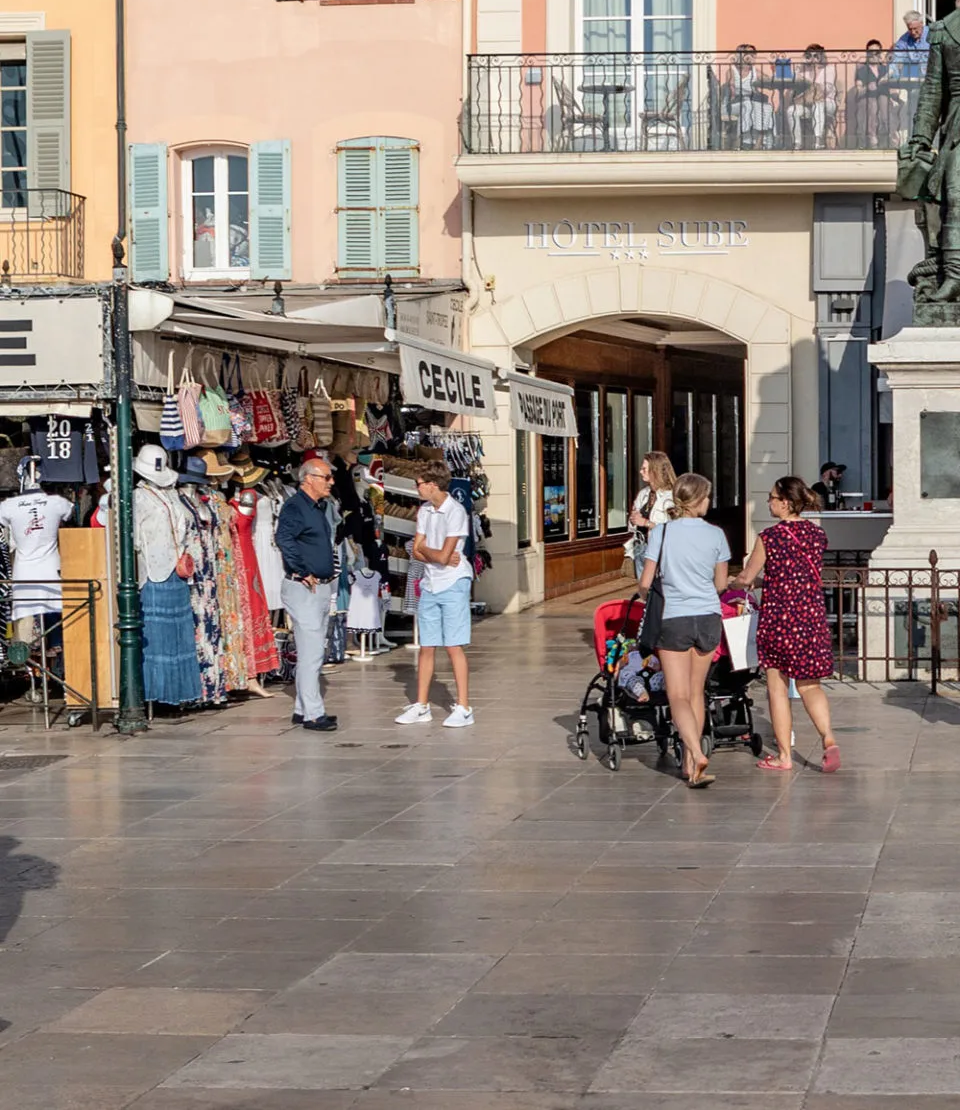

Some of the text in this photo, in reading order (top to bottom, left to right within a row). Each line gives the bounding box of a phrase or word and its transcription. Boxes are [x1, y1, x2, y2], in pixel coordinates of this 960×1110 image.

[523, 219, 748, 249] HÔTEL SUBE
[418, 360, 486, 409] CECILE
[47, 420, 71, 437] 20
[47, 441, 71, 459] 18
